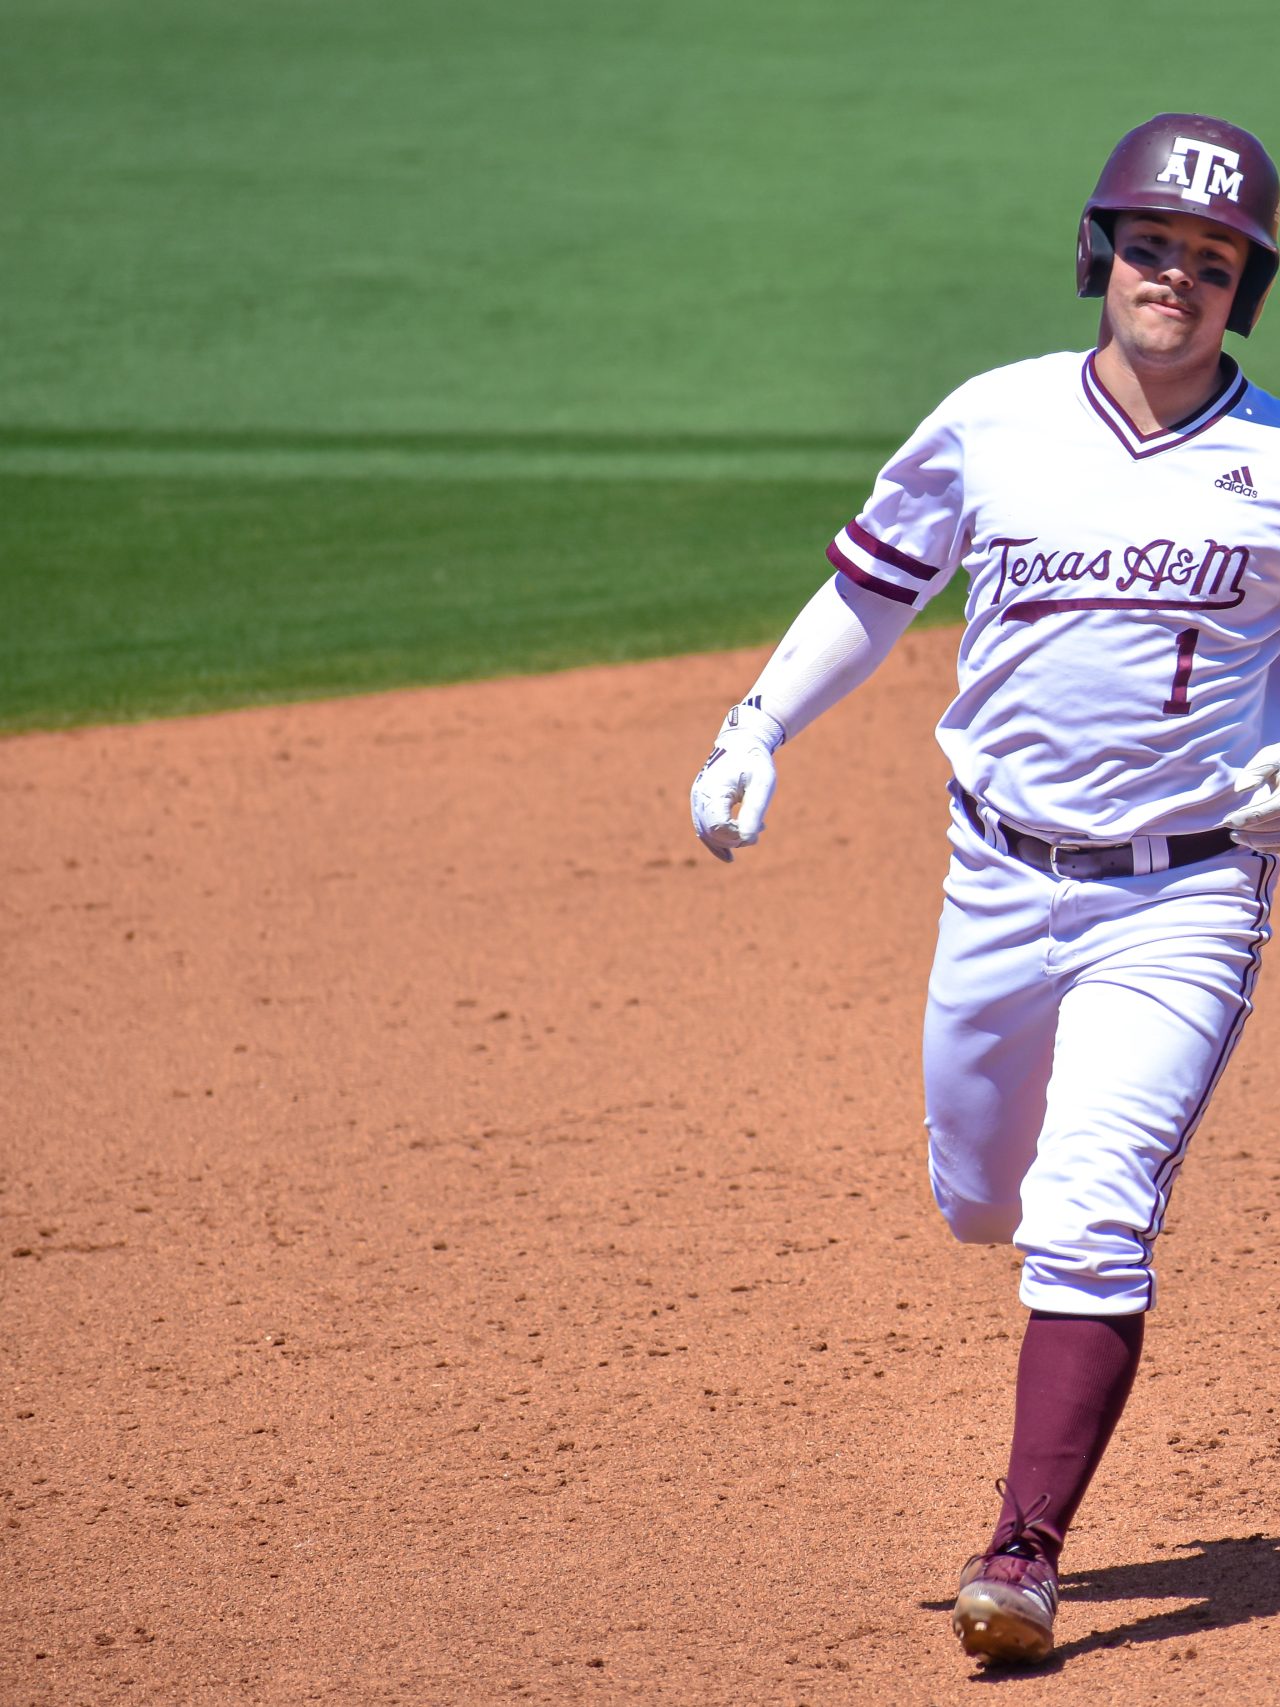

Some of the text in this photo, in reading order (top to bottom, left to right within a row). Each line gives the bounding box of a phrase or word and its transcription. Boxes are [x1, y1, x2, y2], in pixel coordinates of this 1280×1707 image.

[1214, 479, 1258, 499] adidas
[988, 537, 1250, 606] Texas A&M
[1162, 628, 1199, 714] 1
